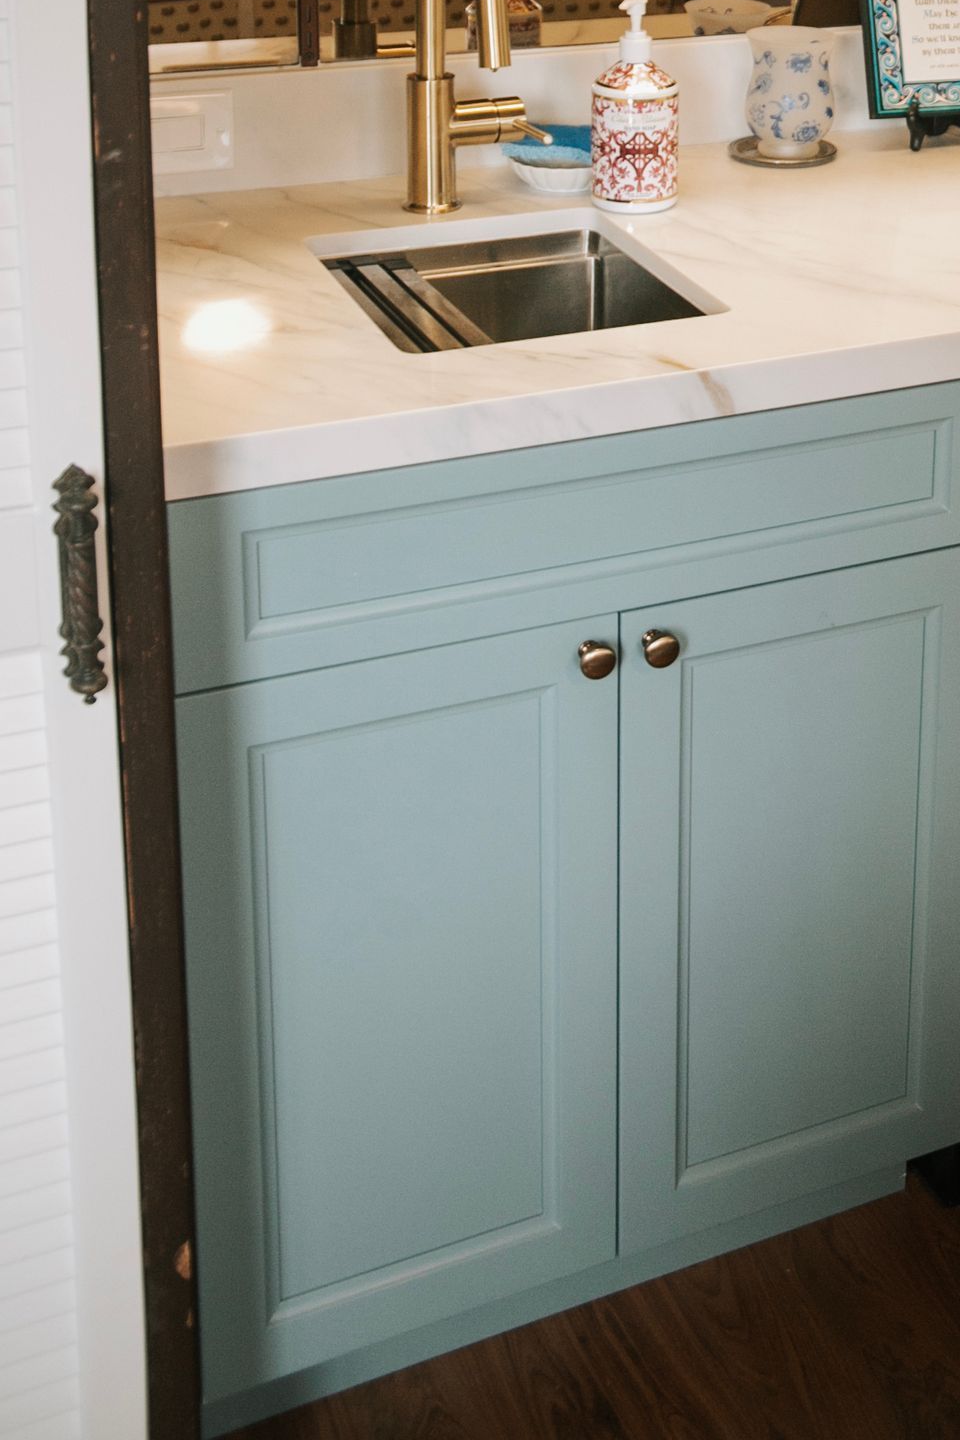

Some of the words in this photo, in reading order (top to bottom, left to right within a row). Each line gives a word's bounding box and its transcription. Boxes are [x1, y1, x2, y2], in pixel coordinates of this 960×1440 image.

[923, 9, 942, 19] May
[928, 23, 951, 31] their
[911, 35, 925, 45] So
[926, 35, 946, 43] we'll
[934, 47, 956, 55] their
